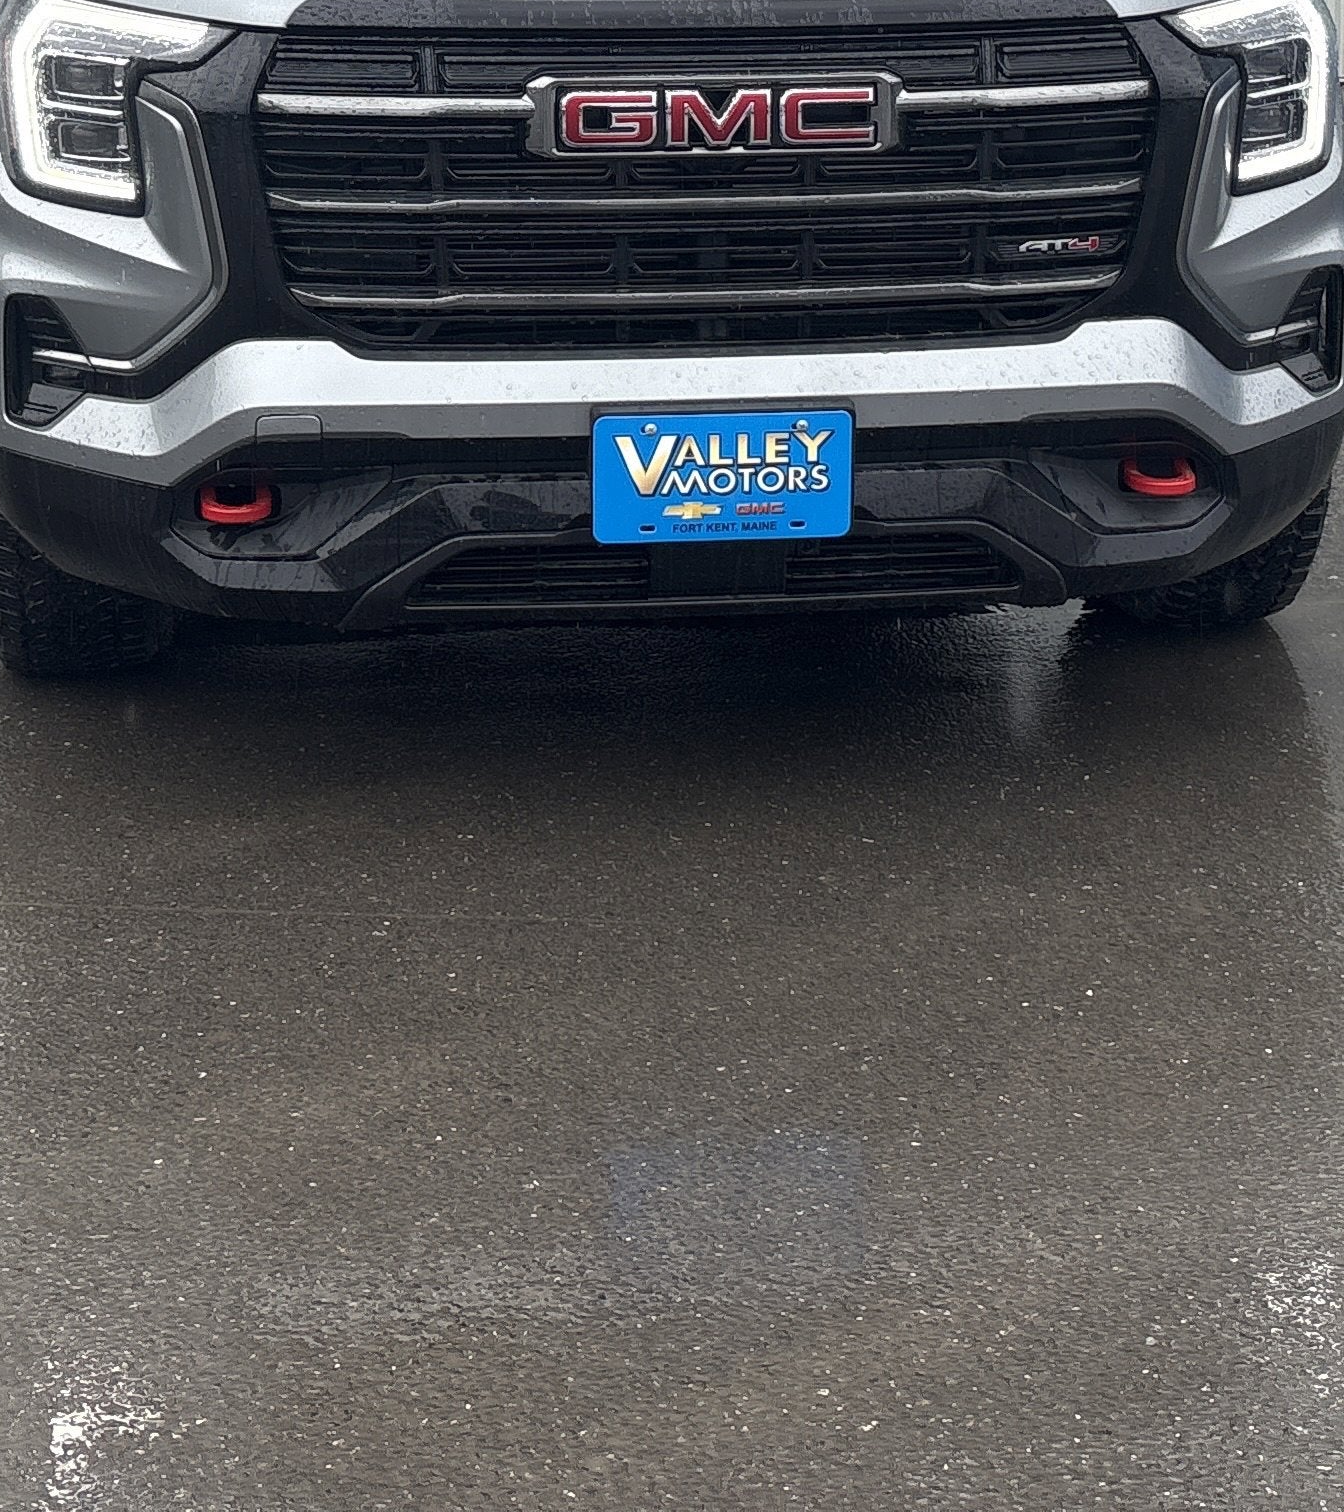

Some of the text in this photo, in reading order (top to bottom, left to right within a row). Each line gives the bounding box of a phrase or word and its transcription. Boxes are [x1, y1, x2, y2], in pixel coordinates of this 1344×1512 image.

[561, 88, 875, 148] GMC
[1019, 236, 1099, 252] AT4
[613, 429, 836, 496] VALLEY
[660, 464, 830, 496] MOTORS
[736, 501, 785, 515] GMC
[672, 521, 777, 533] FORT KENT, MAINE
